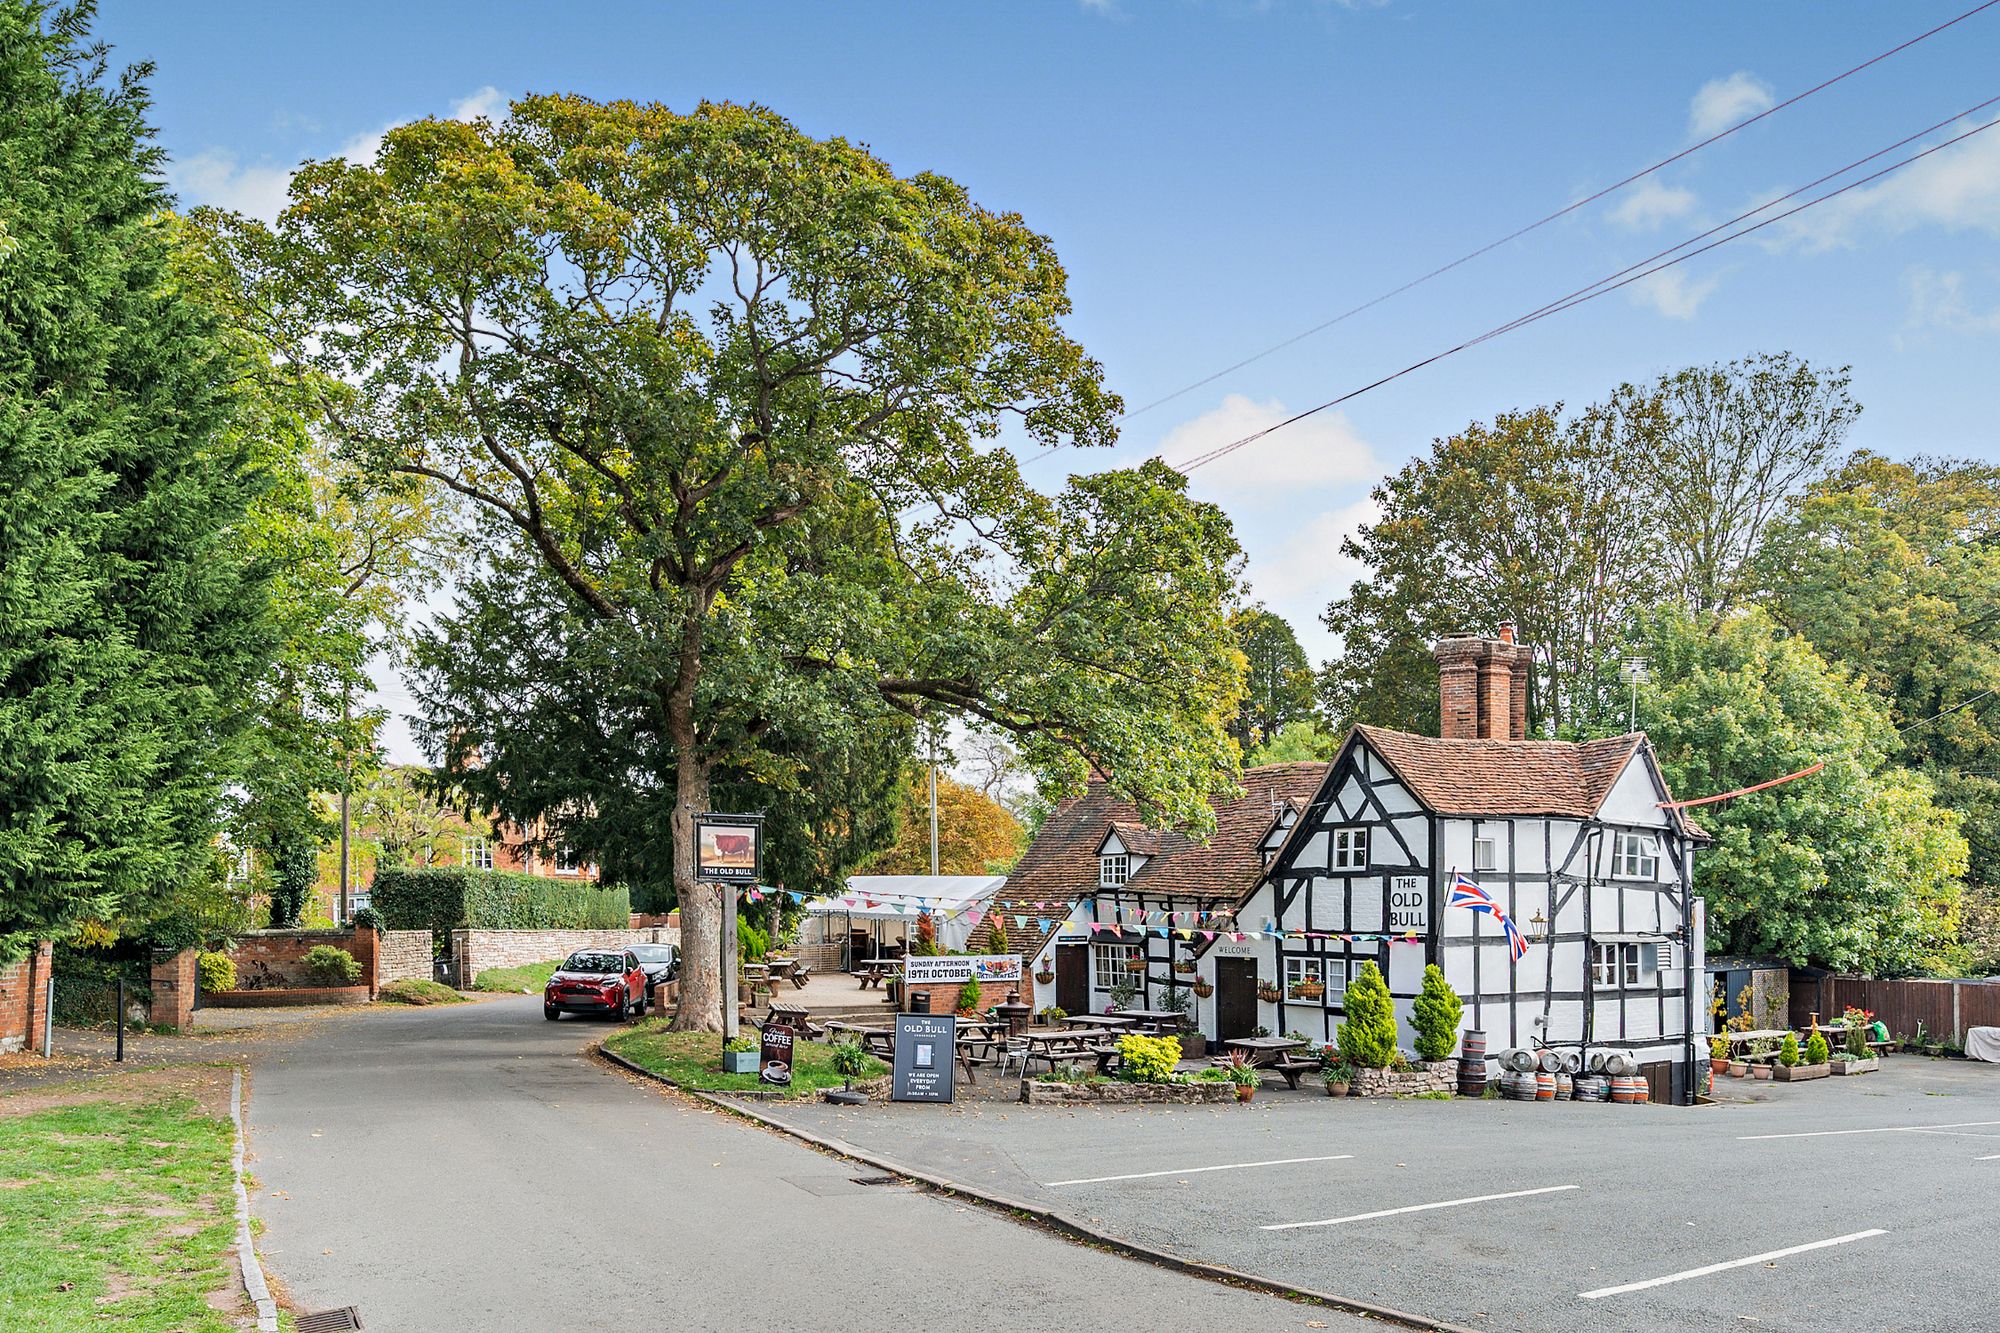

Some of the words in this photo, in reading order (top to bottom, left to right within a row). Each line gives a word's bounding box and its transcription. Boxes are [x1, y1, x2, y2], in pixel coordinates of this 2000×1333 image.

[1396, 878, 1417, 888] THE
[1392, 893, 1423, 907] OLD
[1390, 912, 1426, 927] BULL
[1218, 946, 1251, 955] WELCOME
[910, 960, 933, 968] SUNDAY
[908, 969, 929, 979] 19TH
[931, 969, 972, 978] OCTOBER
[904, 1025, 923, 1033] OLD
[763, 1033, 792, 1045] COFFEE
